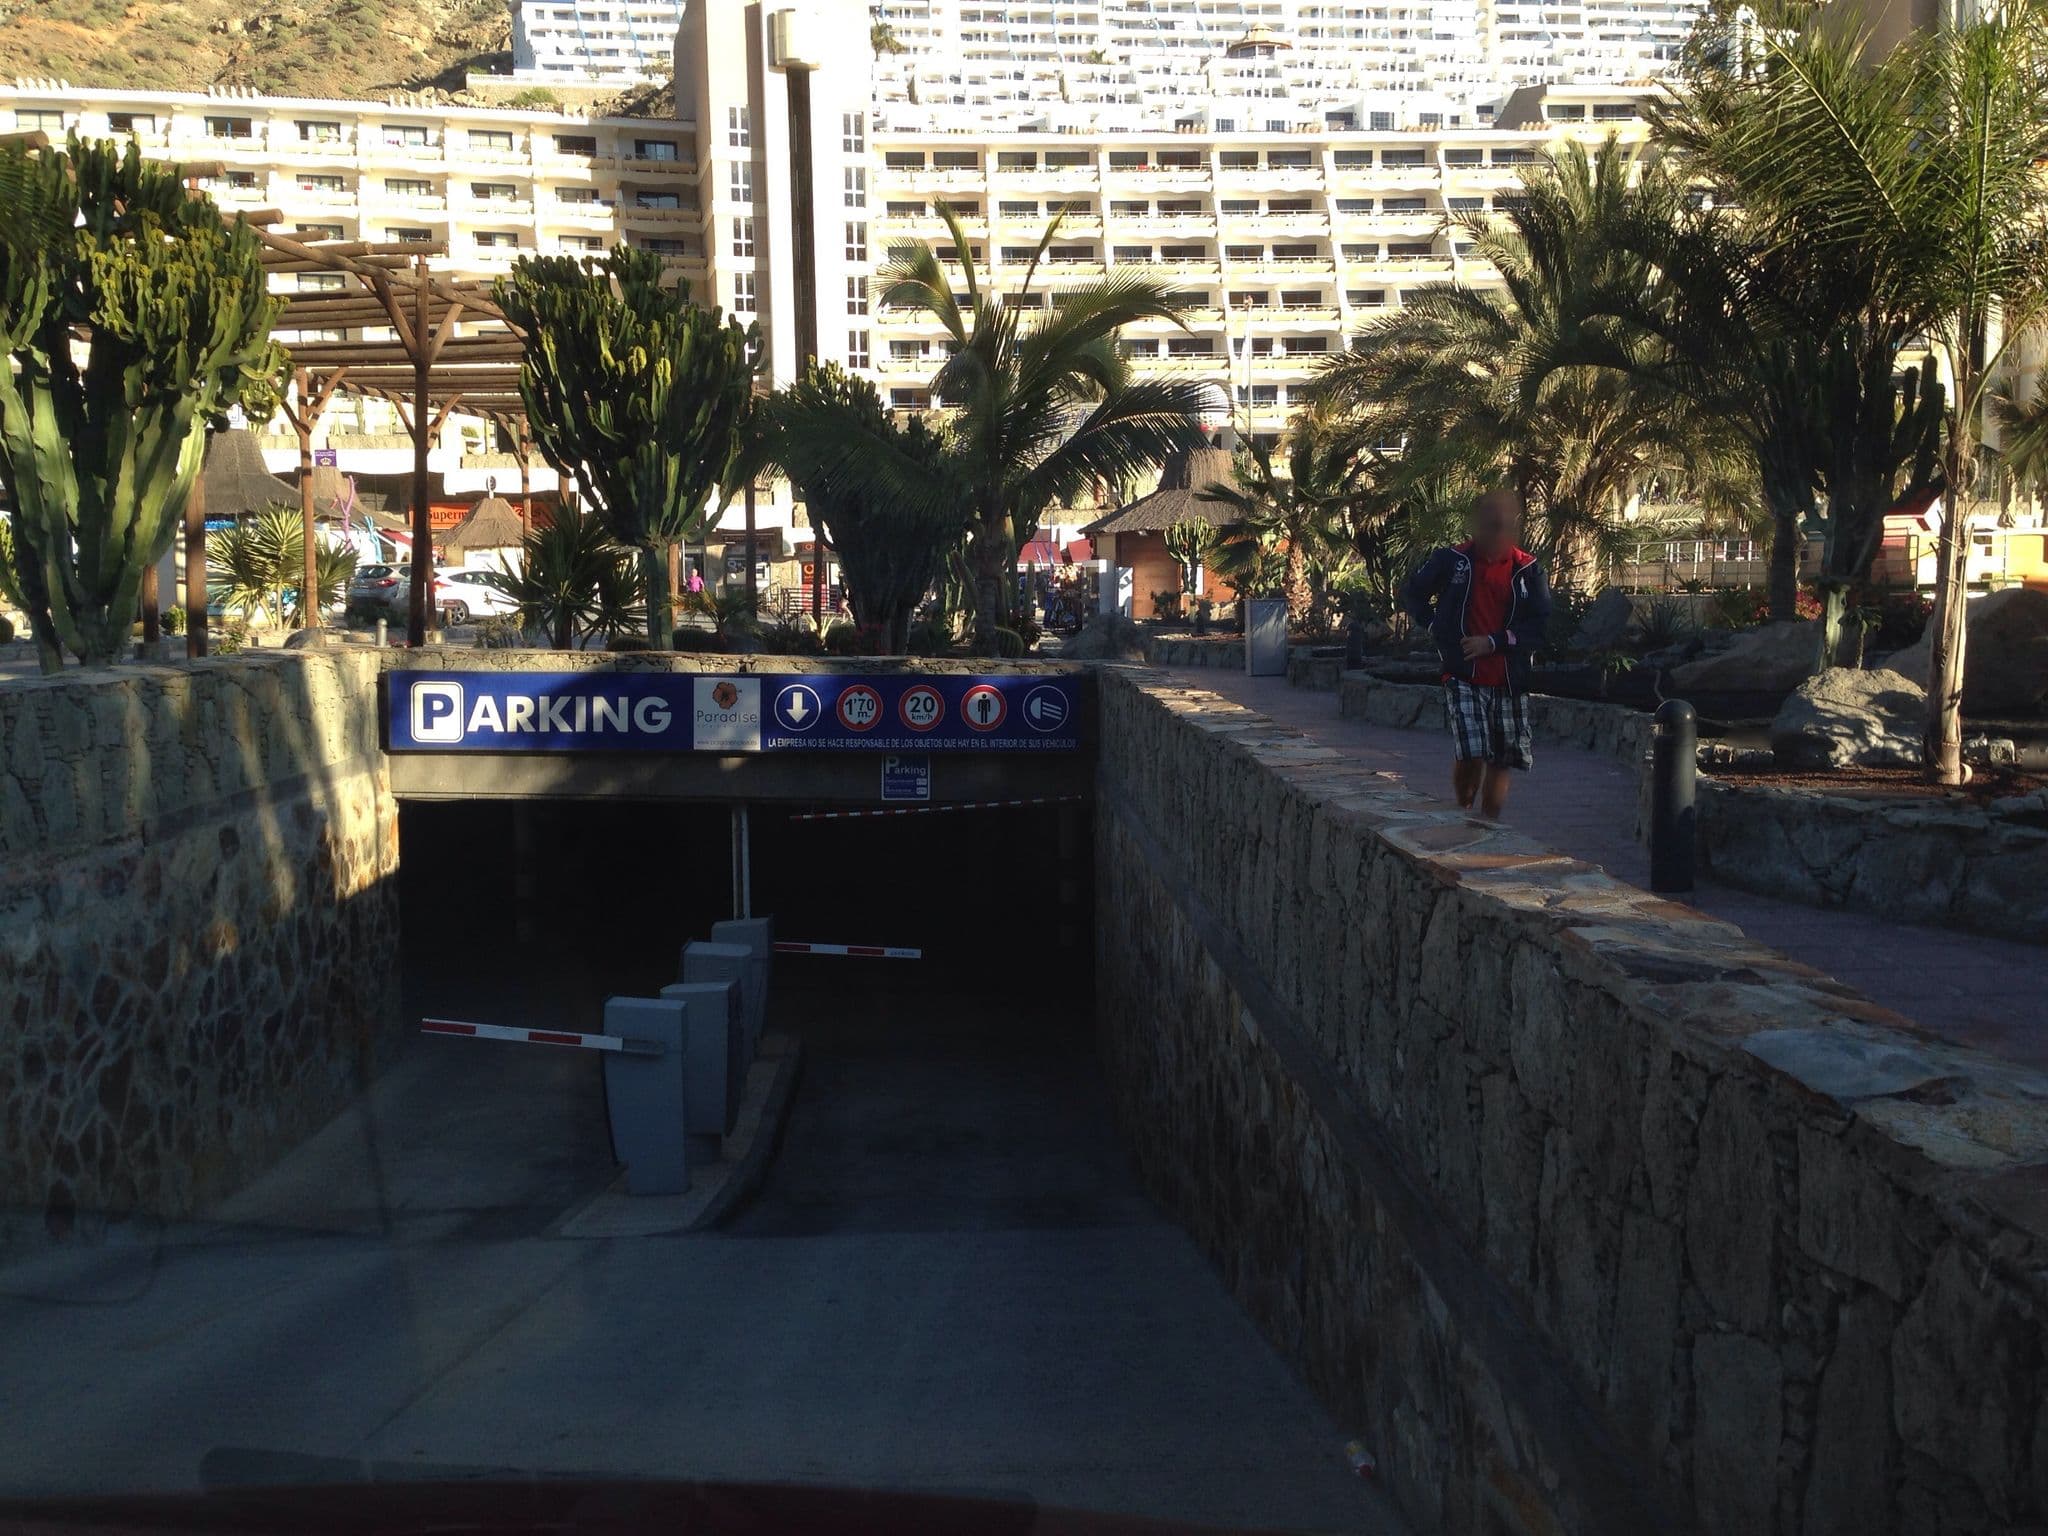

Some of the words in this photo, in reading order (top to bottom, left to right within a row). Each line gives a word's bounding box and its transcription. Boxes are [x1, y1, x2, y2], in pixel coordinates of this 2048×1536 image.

[909, 696, 935, 713] 20
[423, 693, 672, 733] PARKING
[696, 710, 758, 723] Paradise
[911, 713, 933, 721] km/h
[768, 738, 776, 748] LA
[777, 738, 807, 748] EMPRESA
[808, 738, 818, 748] NO
[818, 738, 826, 748] SE
[828, 738, 844, 748] HACE
[891, 738, 900, 748] DE
[901, 738, 914, 748] LOS
[915, 738, 942, 748] OBJETOS
[944, 738, 956, 748] QUE
[958, 738, 970, 748] HAY
[971, 738, 980, 748] EN
[980, 738, 988, 748] EL
[990, 738, 1018, 748] INTERIOR
[1019, 738, 1027, 748] DE
[1028, 738, 1040, 748] SUS
[885, 756, 927, 776] Parking
